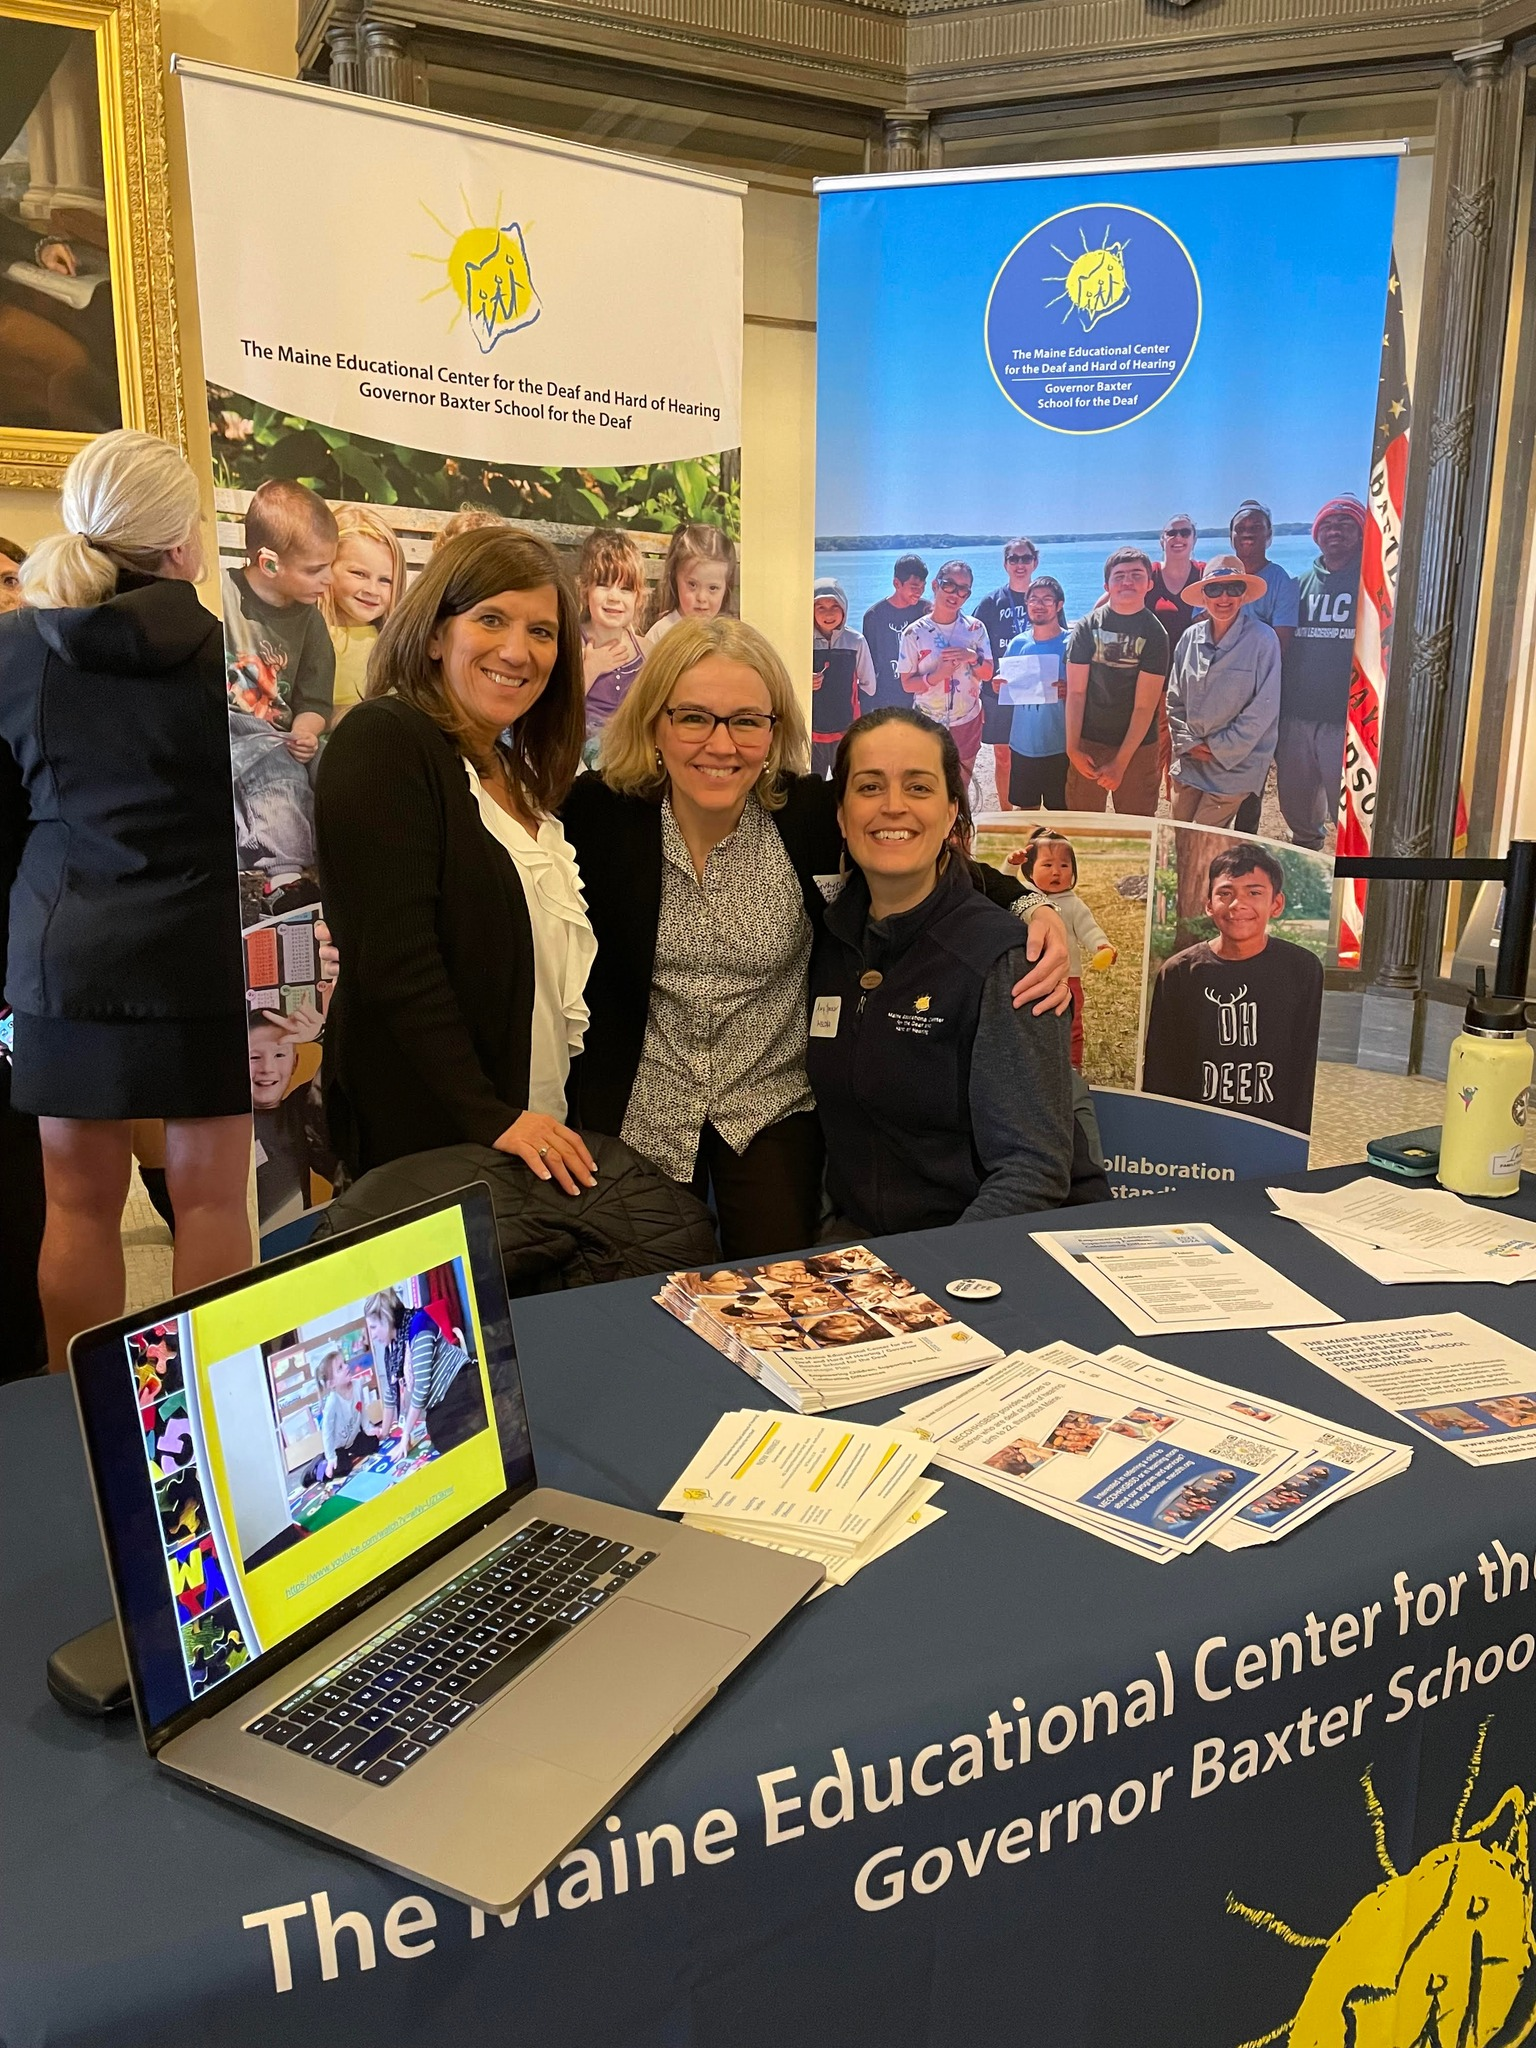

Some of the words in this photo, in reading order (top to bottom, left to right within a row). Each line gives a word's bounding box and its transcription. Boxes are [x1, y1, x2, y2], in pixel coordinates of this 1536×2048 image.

[1004, 363, 1020, 375] for
[1022, 363, 1040, 374] the
[1042, 361, 1067, 374] Deaf
[1068, 360, 1089, 373] and
[1091, 360, 1118, 372] Hard
[1119, 359, 1132, 371] of
[1133, 358, 1176, 371] Hearing
[1012, 349, 1032, 360] The
[1034, 347, 1065, 359] Maine
[1068, 344, 1132, 358] Educational
[1134, 344, 1170, 355] Center
[240, 339, 273, 360] The
[278, 345, 331, 369] Maine
[336, 353, 434, 381] Educational
[437, 367, 490, 389] Center
[493, 373, 515, 391] for
[518, 377, 544, 395] the
[547, 381, 581, 401] Deaf
[583, 386, 611, 404] and
[614, 390, 648, 409] Hard
[650, 394, 666, 411] of
[668, 396, 721, 422] Hearing
[1045, 382, 1095, 394] Governor
[1097, 381, 1133, 391] Baxter
[359, 381, 436, 408] Governor
[439, 391, 491, 414] Baxter
[494, 398, 545, 420] School
[547, 404, 569, 422] for
[571, 407, 596, 425] the
[598, 409, 633, 430] Deaf
[1037, 397, 1073, 409] School
[1075, 396, 1092, 407] for
[1093, 395, 1110, 407] the
[1112, 394, 1139, 406] Deaf
[1307, 593, 1352, 623] YLC
[1218, 1001, 1258, 1047] OH
[1202, 1060, 1274, 1105] DEER
[1103, 1155, 1236, 1182] ollaboration
[242, 1890, 438, 1993] The
[757, 1650, 1176, 1848] Educational
[1193, 1601, 1382, 1702] Center
[1393, 1570, 1468, 1637] for
[1477, 1539, 1536, 1603] th
[853, 1764, 1175, 1912] Governor
[1190, 1692, 1374, 1799] Baxter
[1385, 1632, 1536, 1724] Schoo
